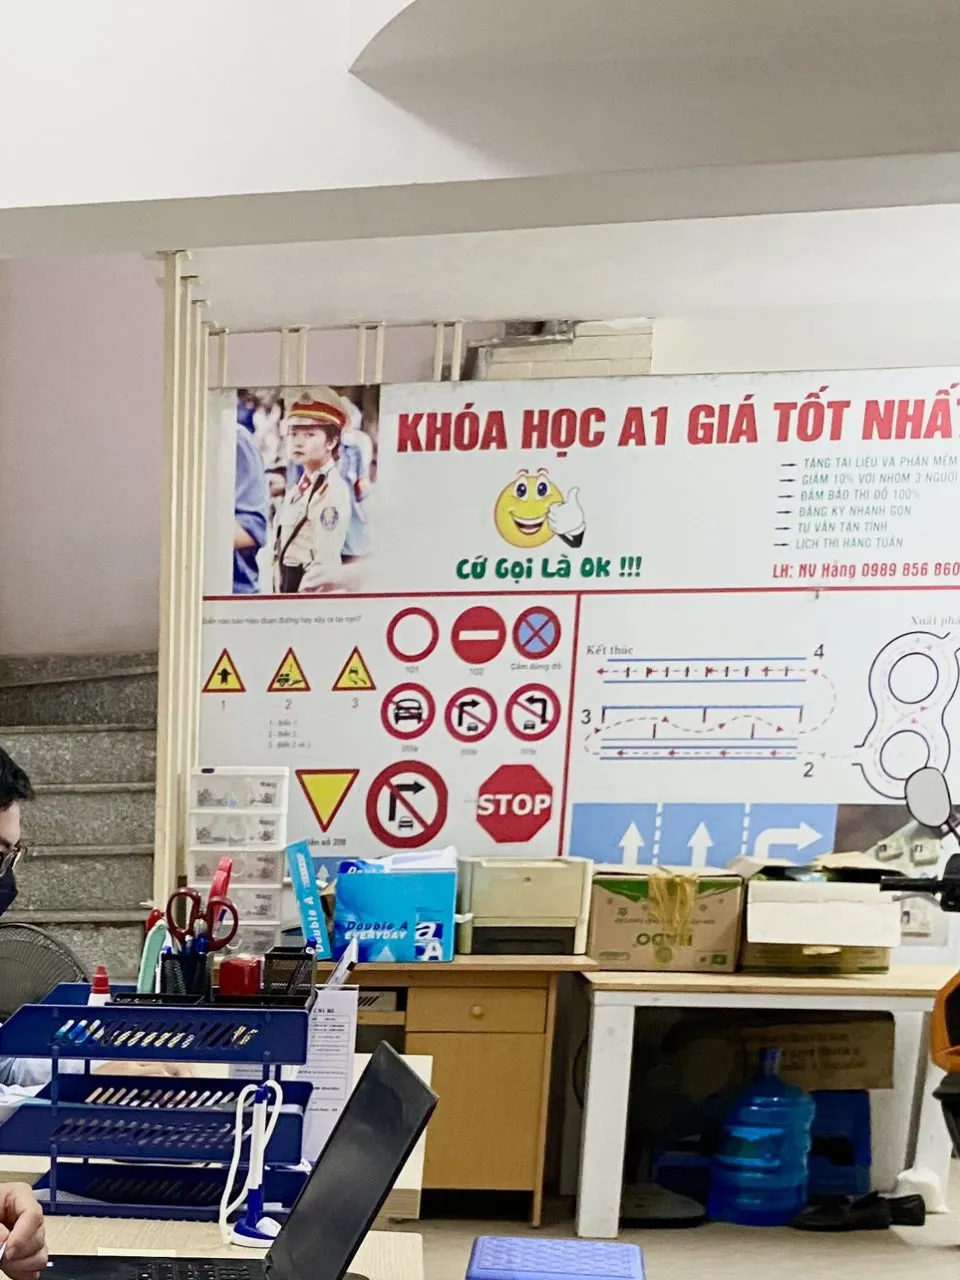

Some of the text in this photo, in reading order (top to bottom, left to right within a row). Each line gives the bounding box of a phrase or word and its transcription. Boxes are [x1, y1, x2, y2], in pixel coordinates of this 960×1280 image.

[397, 382, 960, 458] KHÓA HỌC A1 GIÁ TỐT NHẤ
[854, 487, 870, 500] THI
[849, 503, 887, 517] NHANH
[495, 557, 533, 584] Gọi
[541, 554, 571, 579] Là
[619, 555, 642, 578] !!!
[860, 561, 898, 578] 0989
[901, 561, 930, 577] 856
[813, 643, 825, 660] 4
[284, 699, 293, 711] 2
[351, 697, 360, 709] 3
[580, 708, 592, 725] 3
[802, 762, 814, 779] 2
[477, 793, 551, 816] STOP
[346, 920, 409, 931] Double A
[344, 930, 409, 941] EVERYDAY
